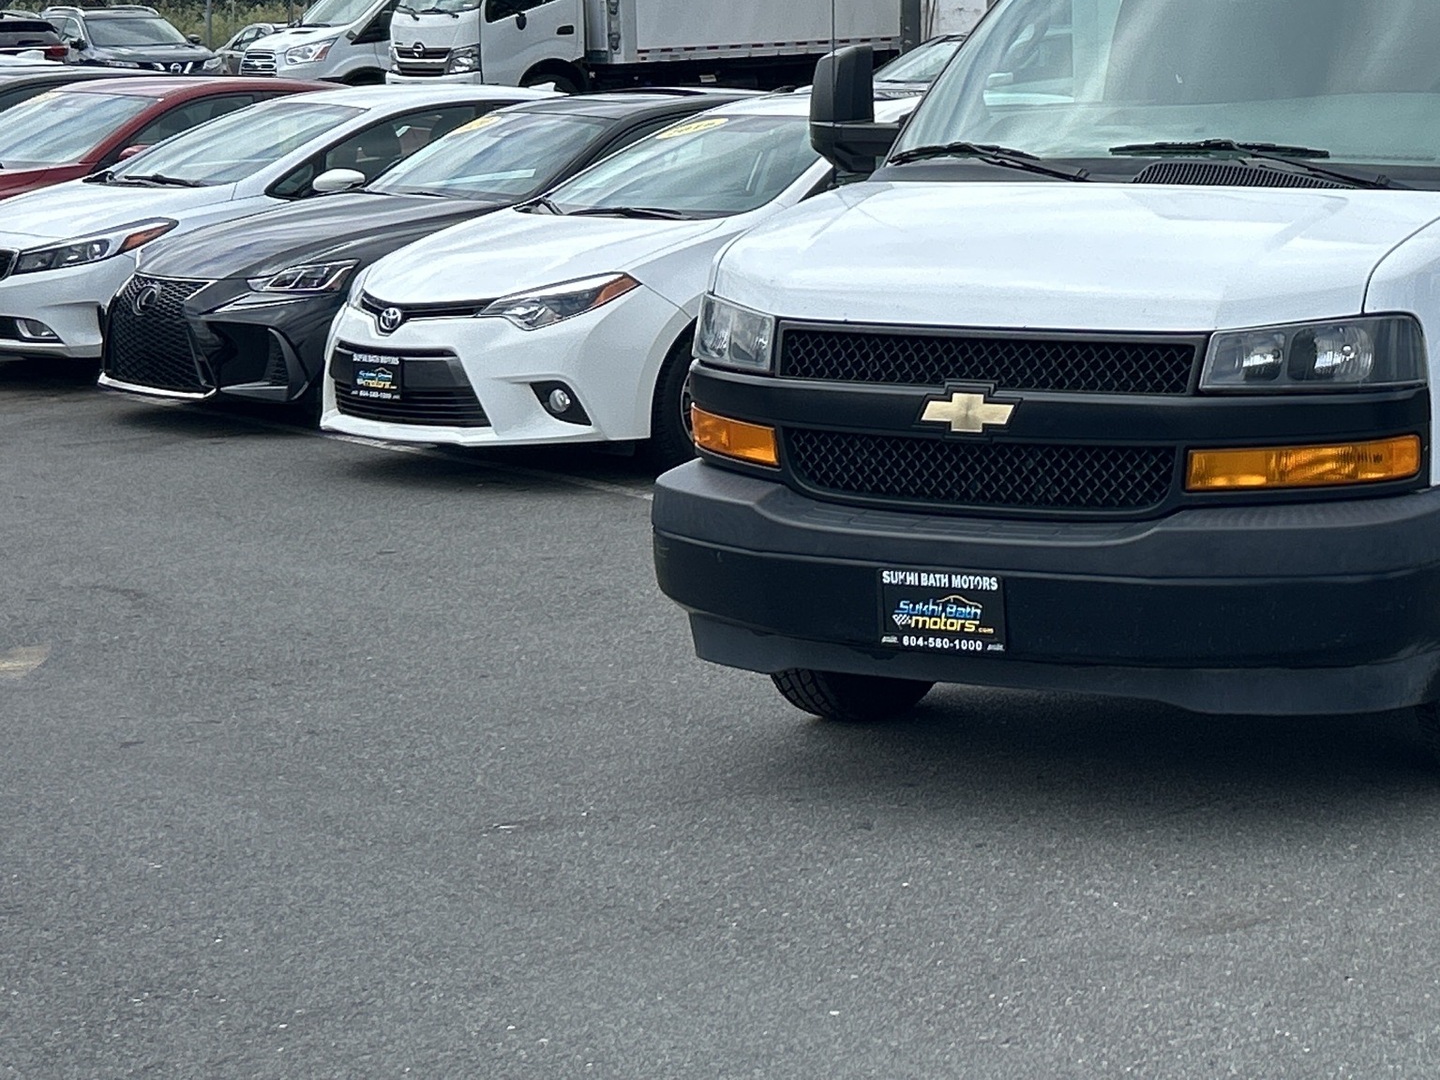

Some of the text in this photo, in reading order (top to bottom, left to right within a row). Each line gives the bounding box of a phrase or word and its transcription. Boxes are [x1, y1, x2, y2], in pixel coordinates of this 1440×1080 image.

[882, 570, 998, 591] SUKHI BATH MOTORS
[895, 599, 982, 619] Sukhi Bath
